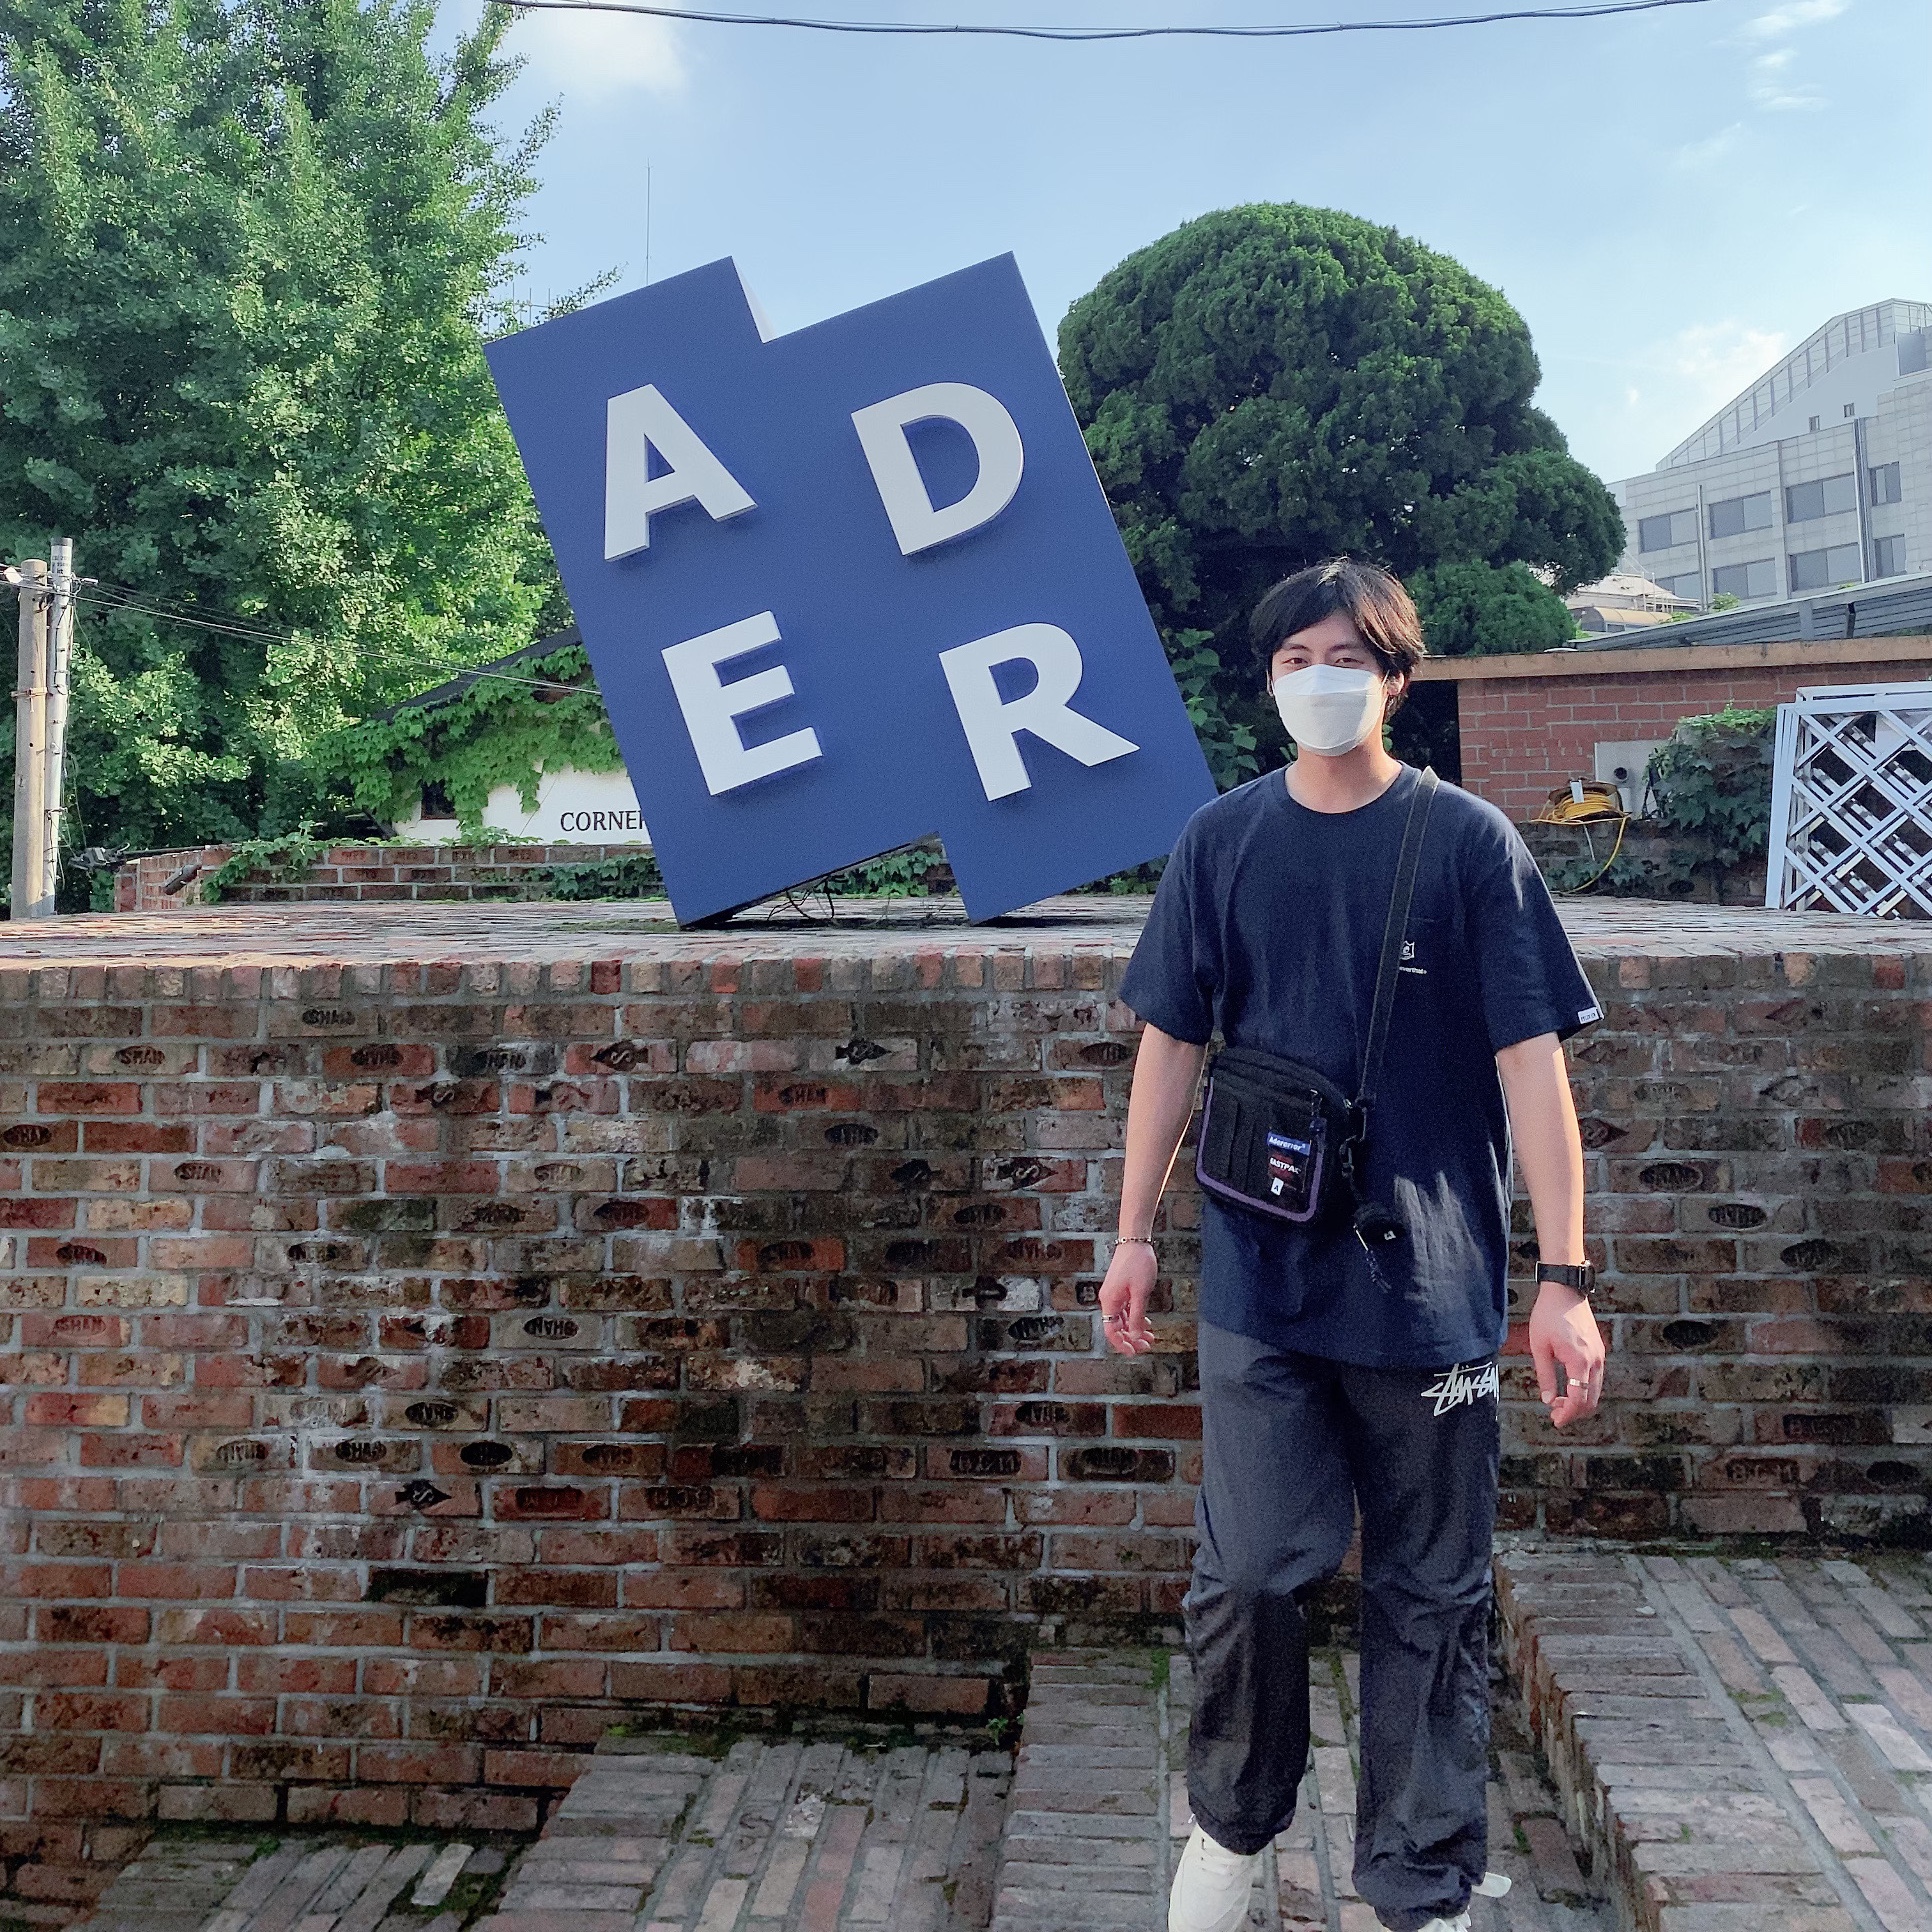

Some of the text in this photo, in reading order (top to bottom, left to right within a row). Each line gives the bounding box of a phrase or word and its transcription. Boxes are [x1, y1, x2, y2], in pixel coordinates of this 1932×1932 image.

[604, 382, 1025, 561] A D
[661, 610, 1141, 802] E R
